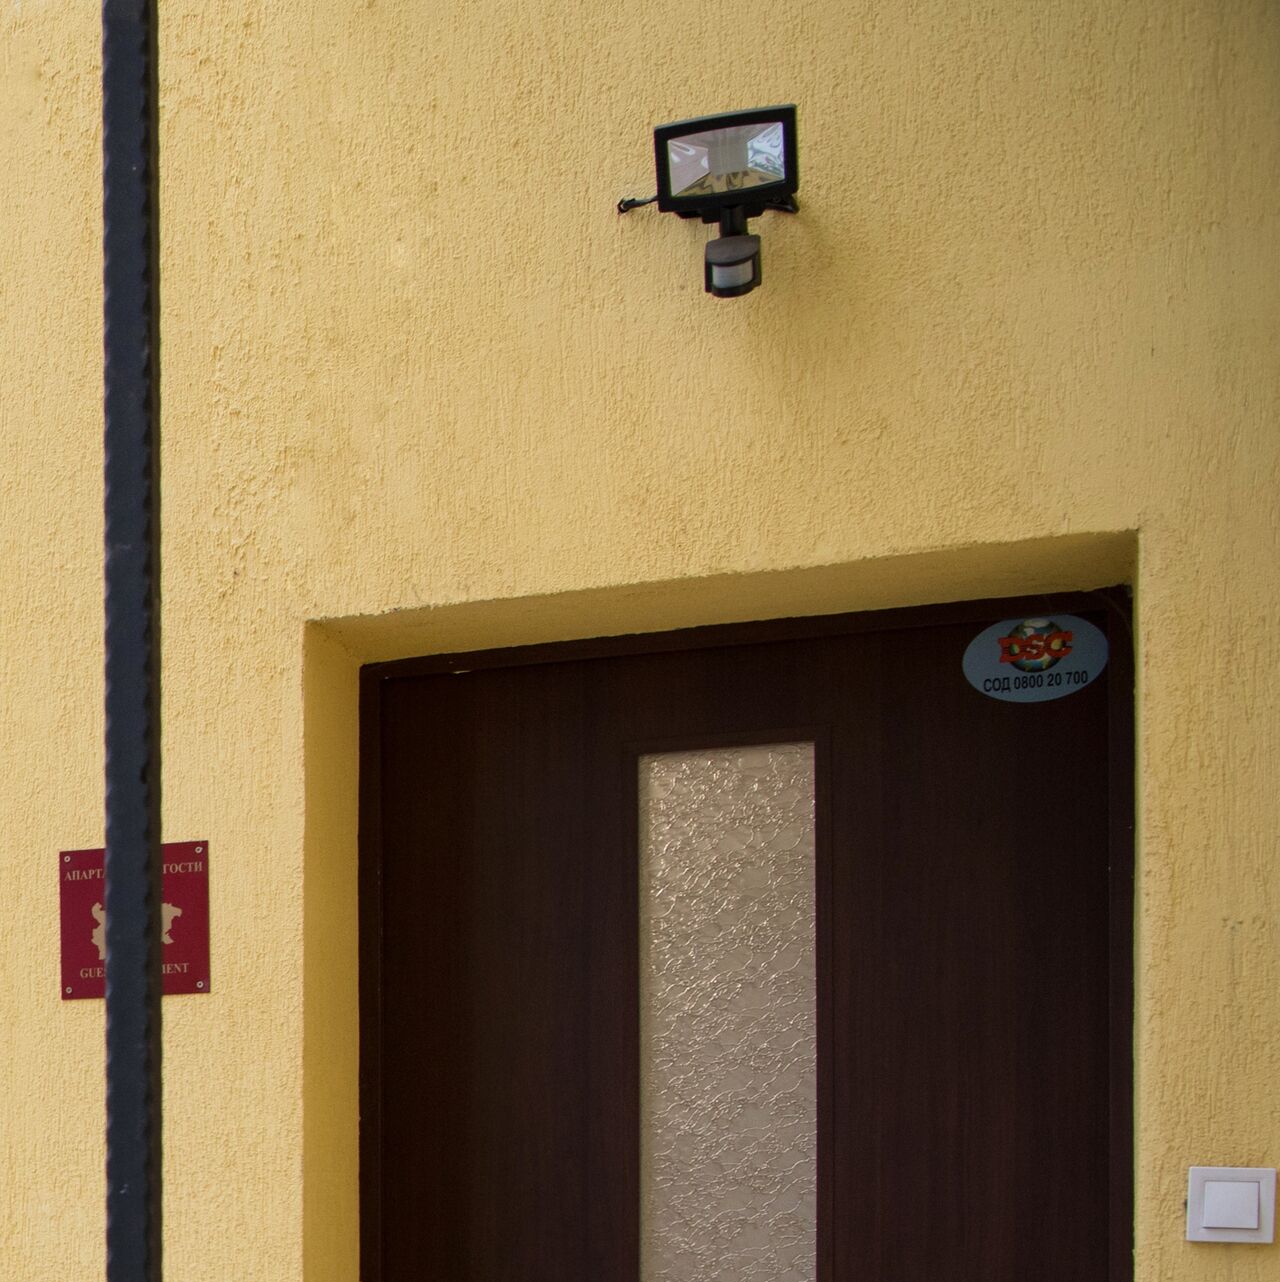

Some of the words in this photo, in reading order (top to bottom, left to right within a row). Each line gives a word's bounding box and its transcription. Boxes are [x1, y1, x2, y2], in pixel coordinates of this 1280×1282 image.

[1014, 675, 1043, 690] 0800
[1047, 673, 1062, 686] 20
[1066, 670, 1089, 684] 700
[80, 967, 106, 978] GUE
